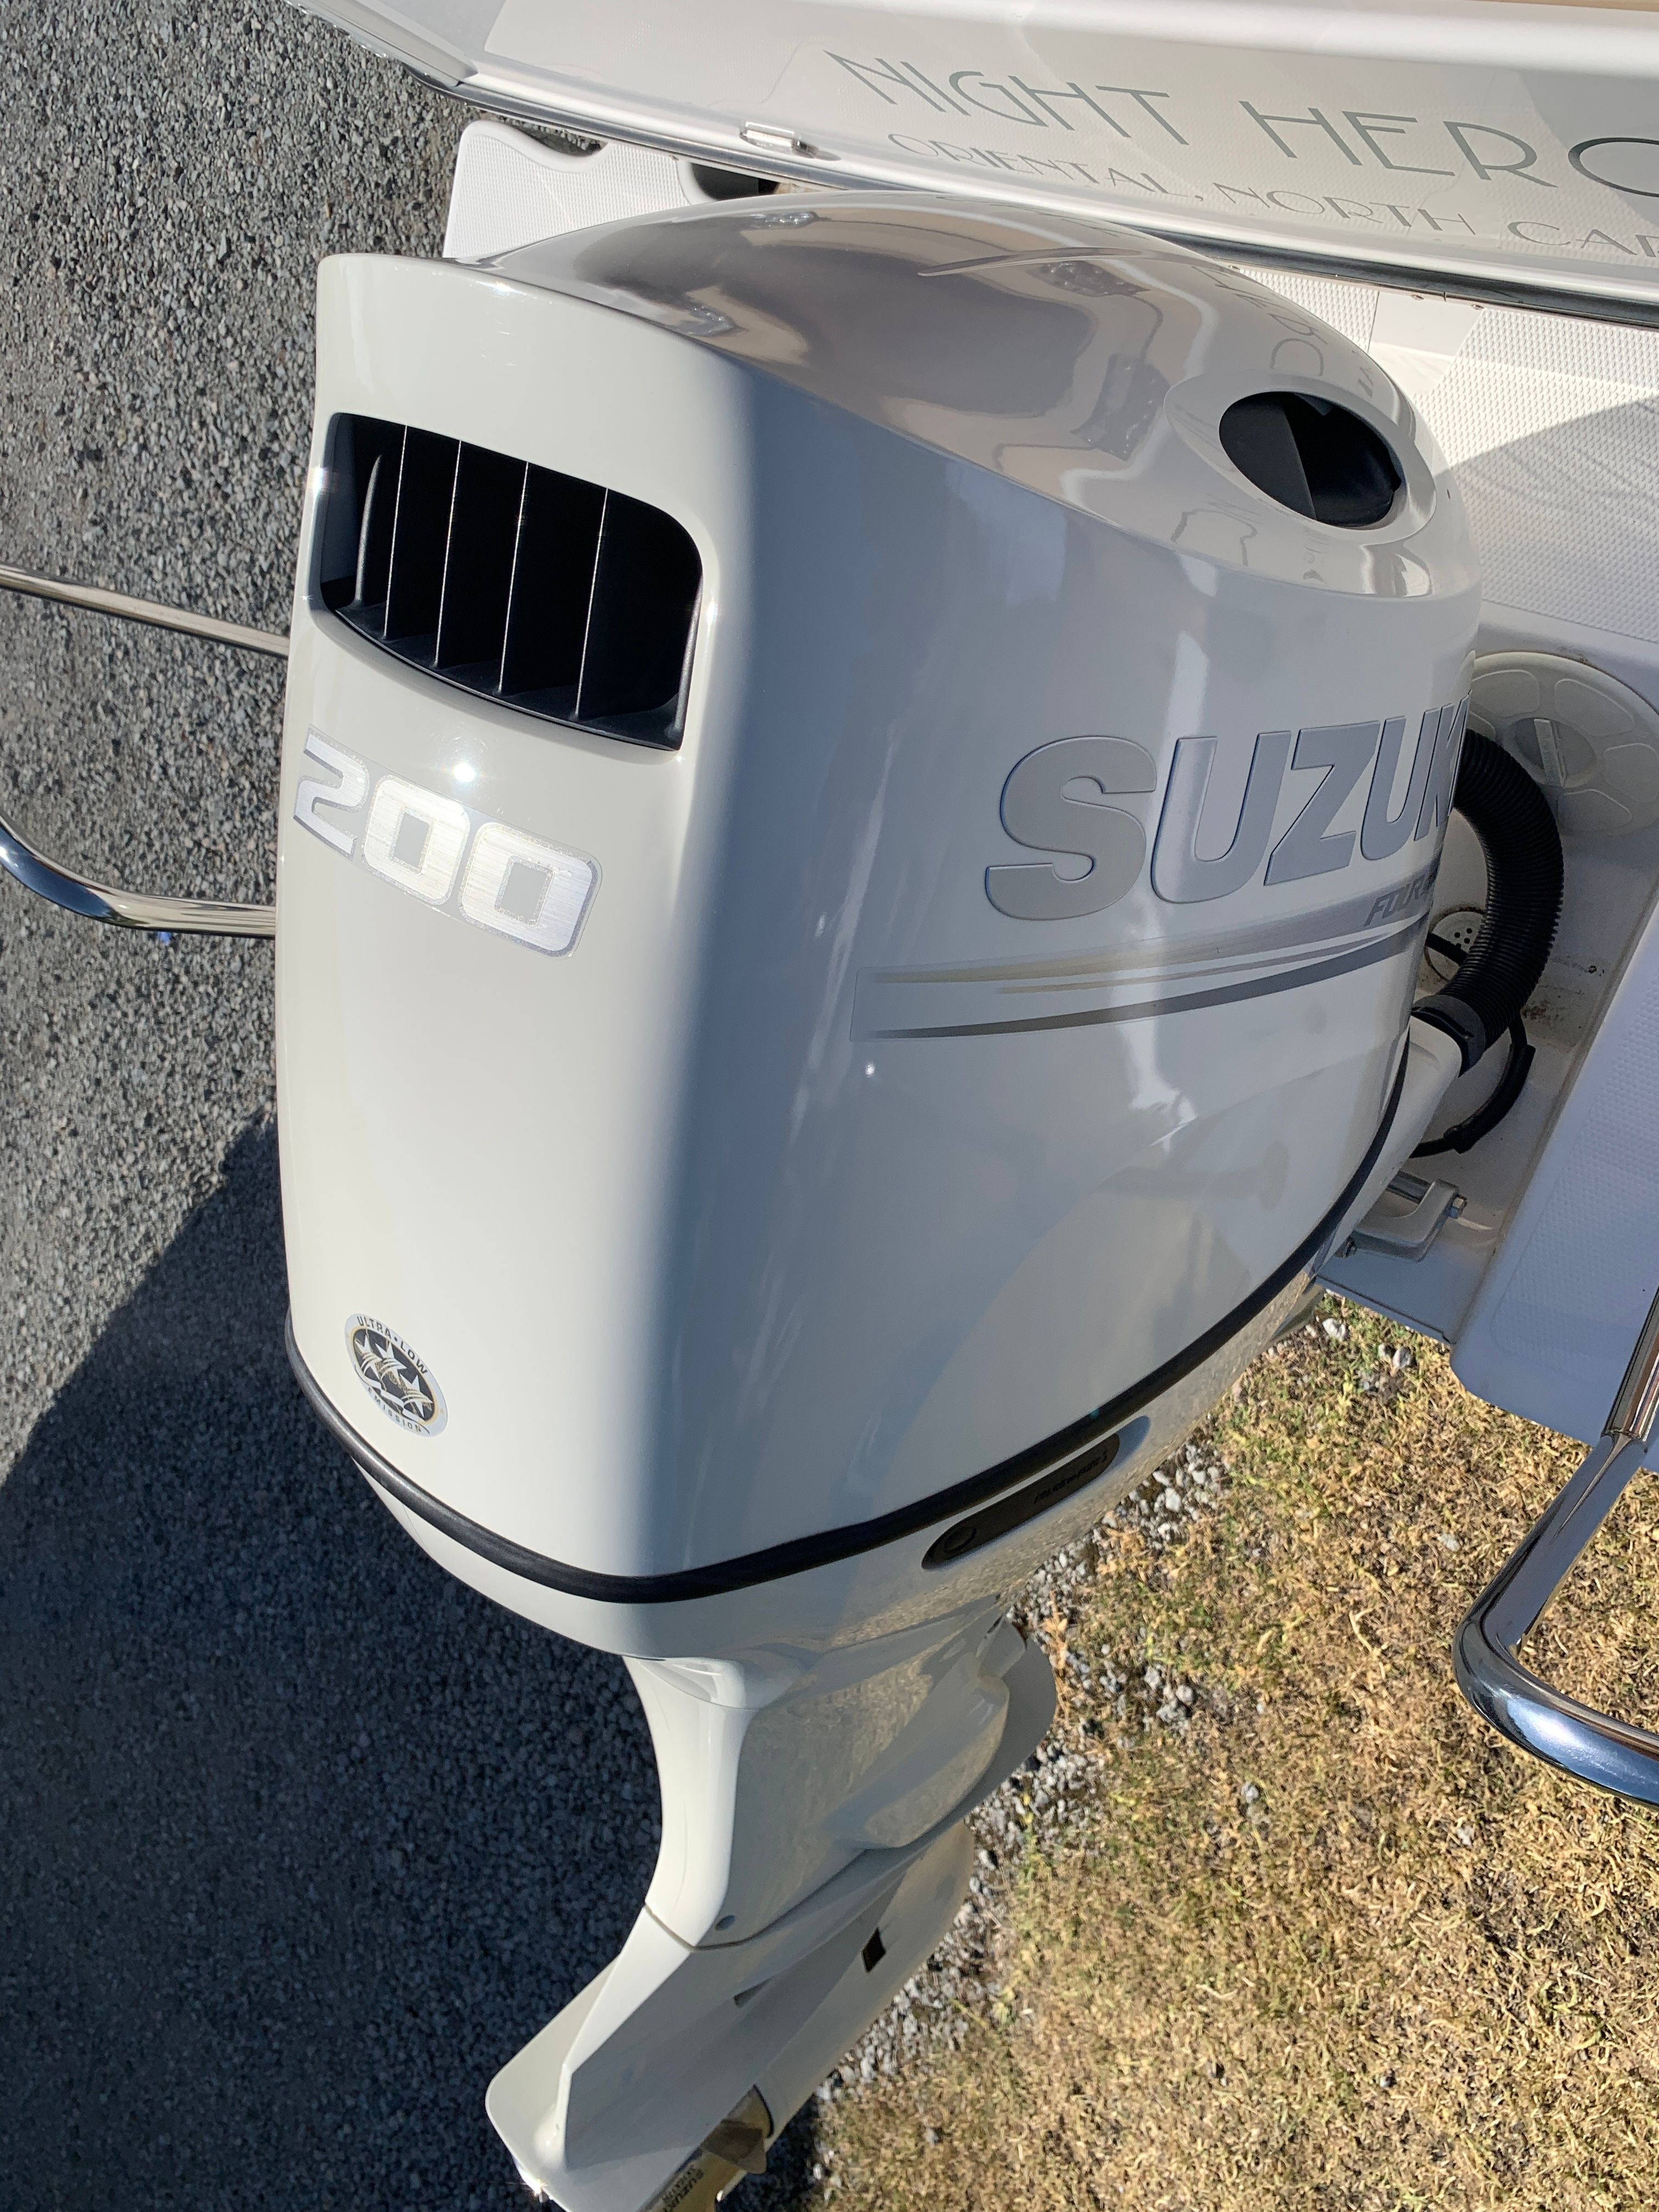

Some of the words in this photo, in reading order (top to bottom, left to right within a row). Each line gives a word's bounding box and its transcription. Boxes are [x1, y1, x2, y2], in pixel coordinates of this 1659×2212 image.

[823, 49, 1189, 145] NIGHT
[888, 133, 1204, 201] ORIENTAL,
[1212, 182, 1476, 235] NORTH
[292, 724, 599, 958] 200
[985, 690, 1471, 921] SUZUK
[357, 1316, 392, 1340] ULTRA
[400, 1340, 428, 1374] LOW
[368, 1387, 422, 1432] EMISSION
